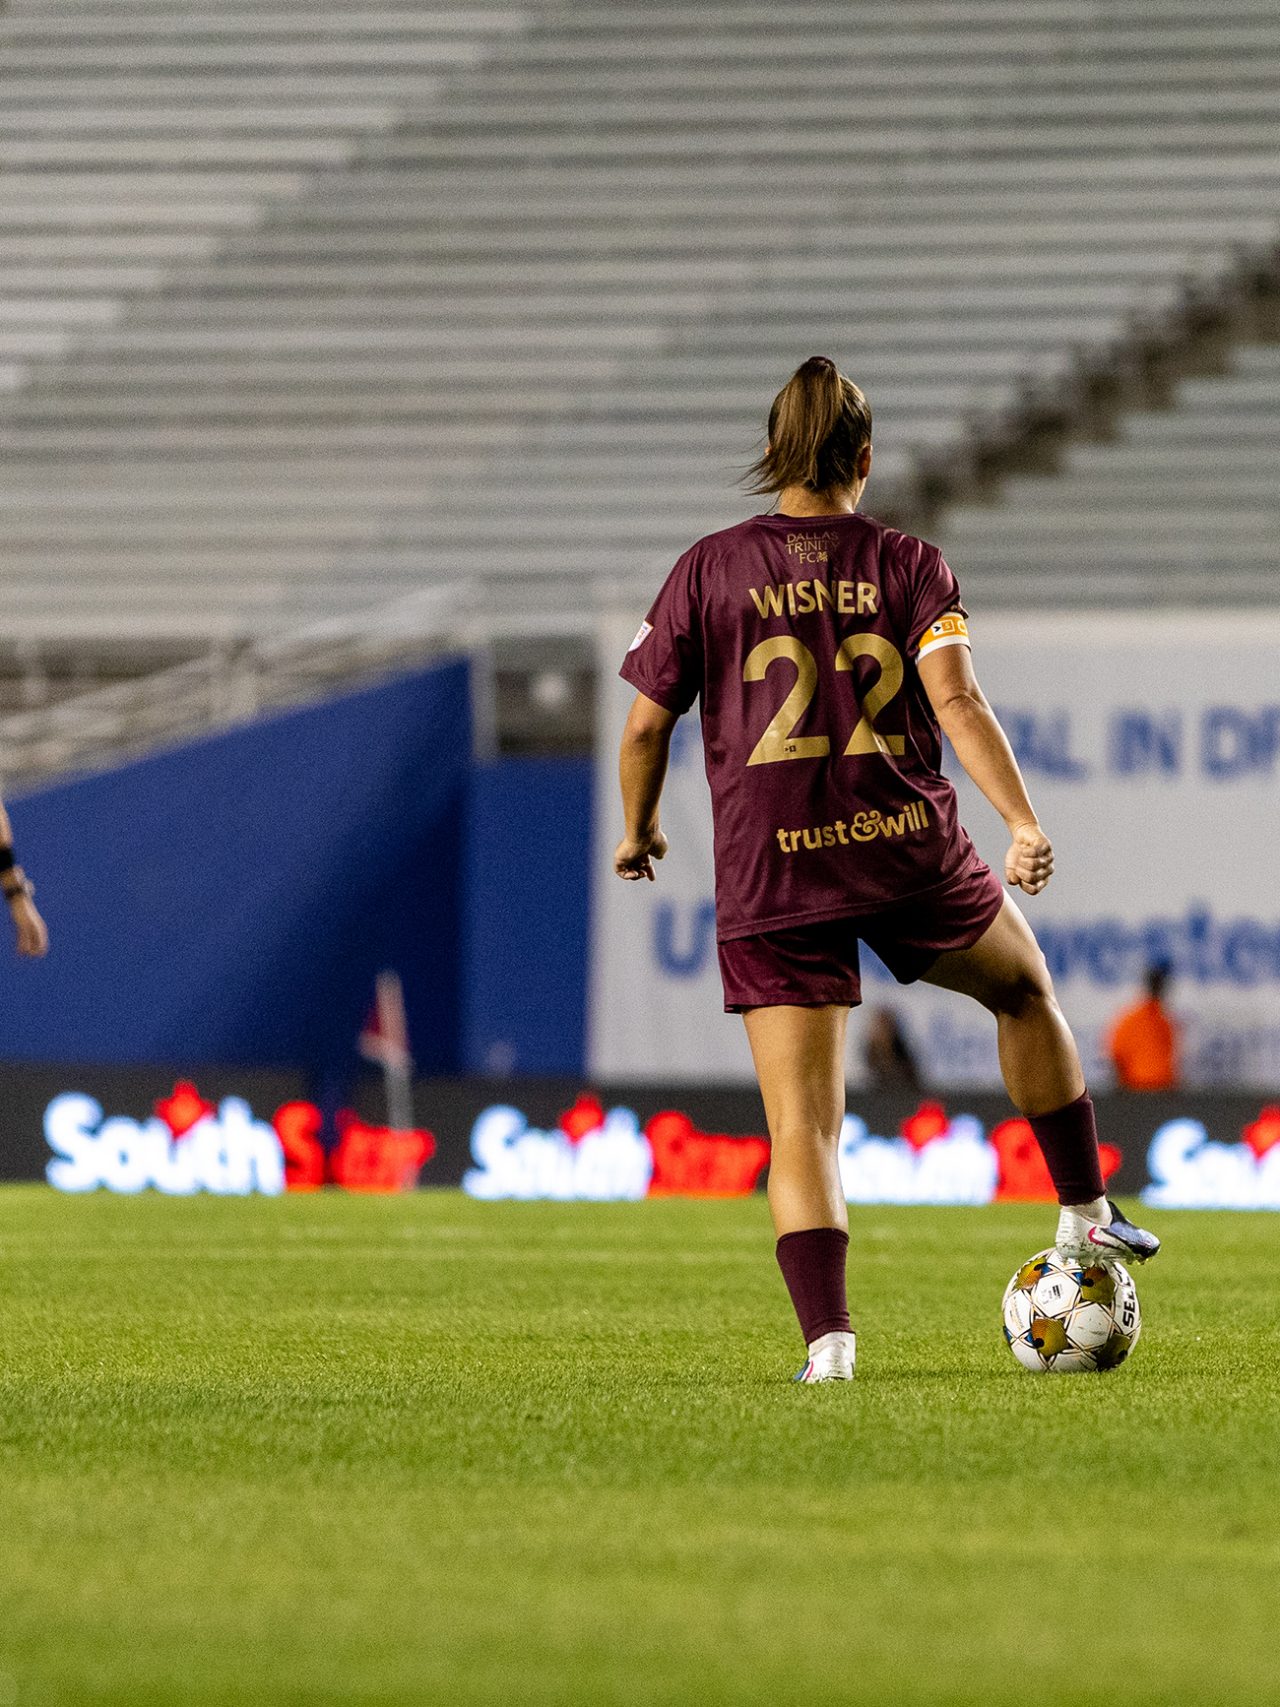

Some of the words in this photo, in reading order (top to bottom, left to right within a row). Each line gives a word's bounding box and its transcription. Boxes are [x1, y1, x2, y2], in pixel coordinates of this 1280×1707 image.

[784, 540, 840, 555] TRINITY
[786, 531, 839, 543] DALLAS
[799, 551, 816, 564] FC
[748, 579, 878, 619] WISNER
[743, 633, 905, 766] 22
[655, 899, 716, 979] U
[44, 1091, 287, 1194] South
[461, 1103, 652, 1200] South
[842, 1112, 997, 1206] outh
